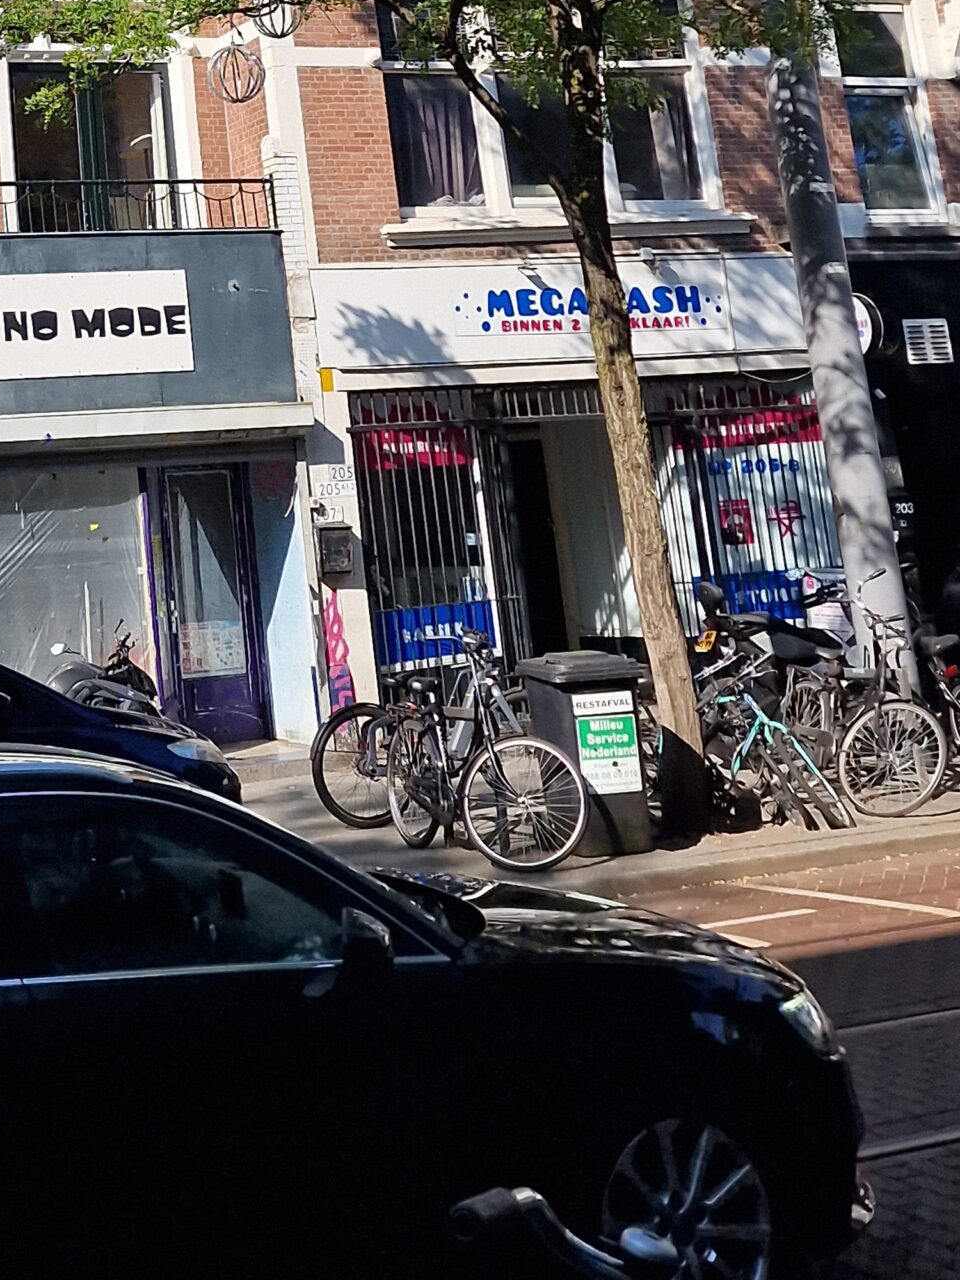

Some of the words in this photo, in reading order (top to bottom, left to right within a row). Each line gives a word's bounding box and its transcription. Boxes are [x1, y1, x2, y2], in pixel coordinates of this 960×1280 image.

[487, 285, 702, 317] MEGAASH
[71, 305, 186, 338] MODE
[501, 319, 563, 332] BINNEN
[572, 320, 581, 331] 2
[331, 466, 353, 480] 205
[895, 502, 914, 514] 203
[576, 698, 631, 710] RESTAFVAL
[586, 732, 629, 745] Service
[581, 744, 637, 758] Nederland
